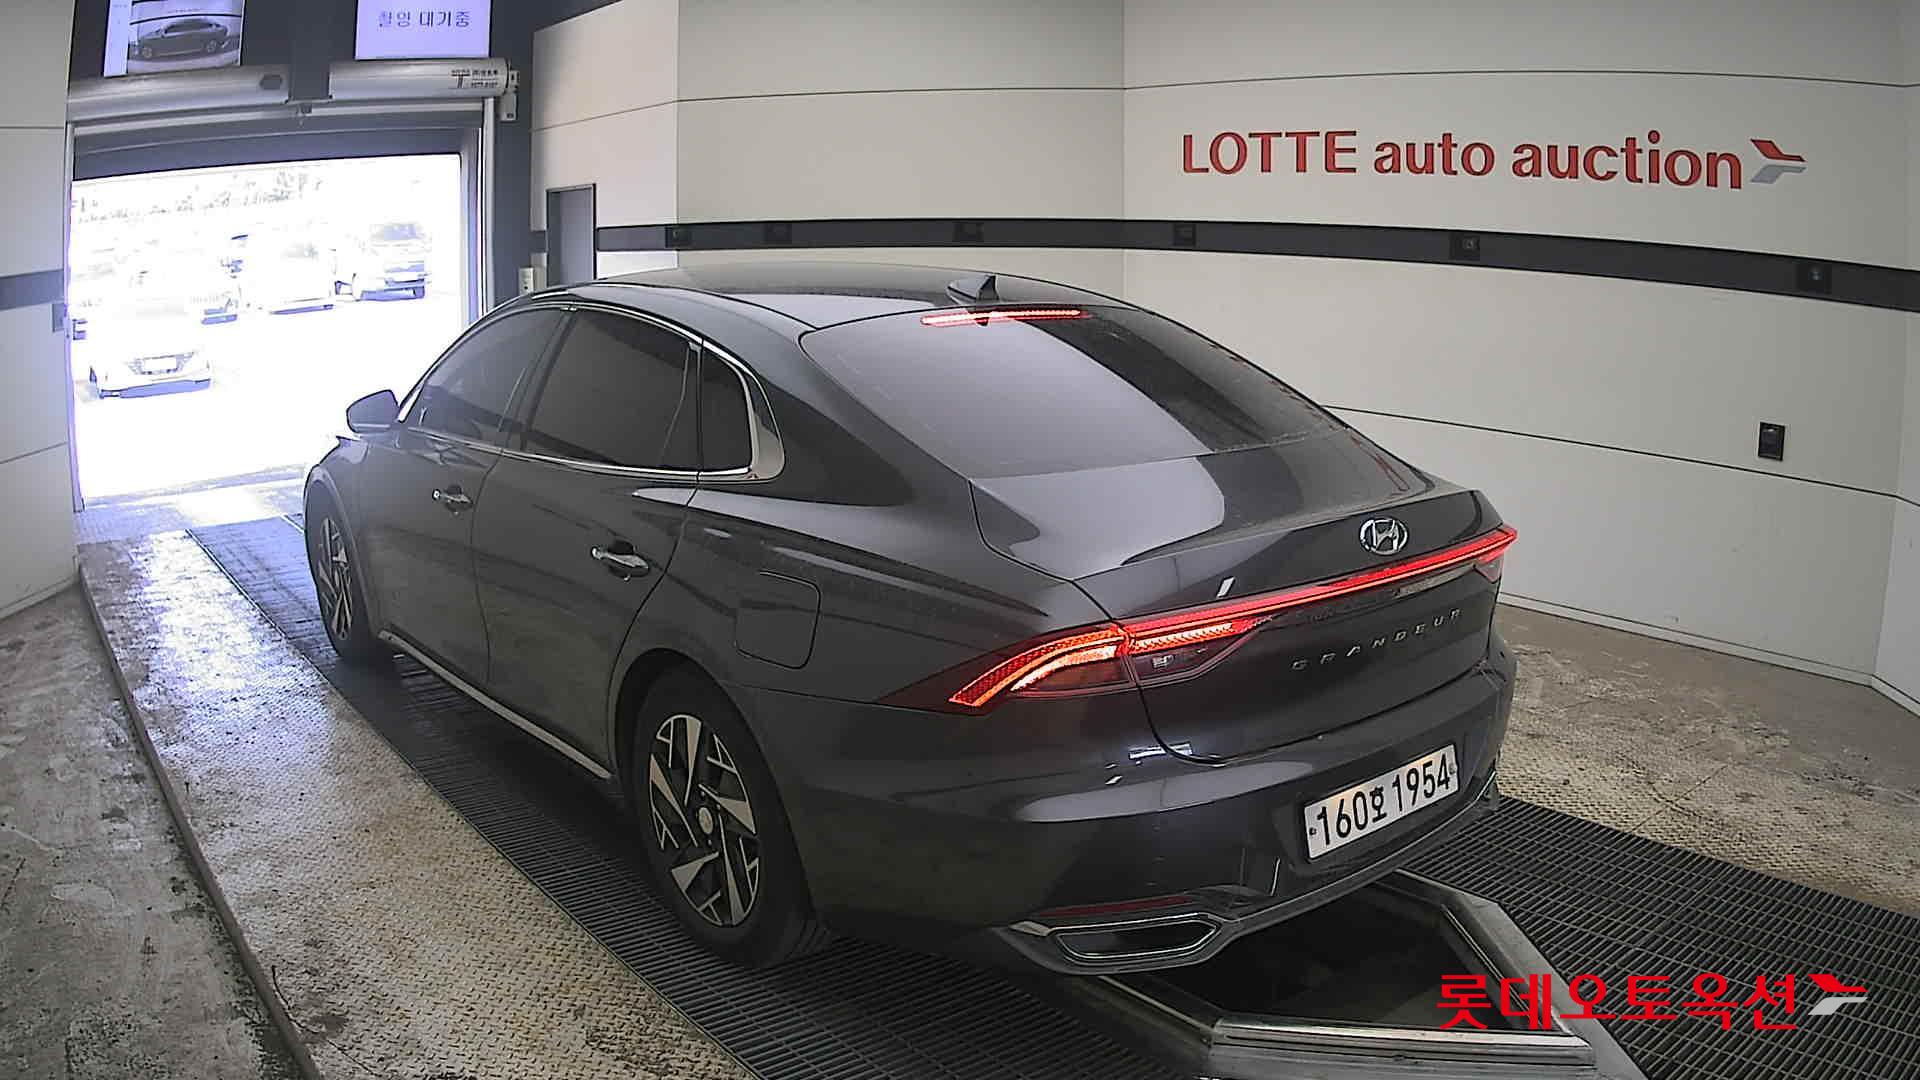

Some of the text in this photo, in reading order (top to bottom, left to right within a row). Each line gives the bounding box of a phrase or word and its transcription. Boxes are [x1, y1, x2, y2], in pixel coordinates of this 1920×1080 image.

[419, 11, 470, 28] 대기중
[1183, 130, 1742, 189] LOTTE auto auction
[1291, 608, 1461, 670] GRANDEUR
